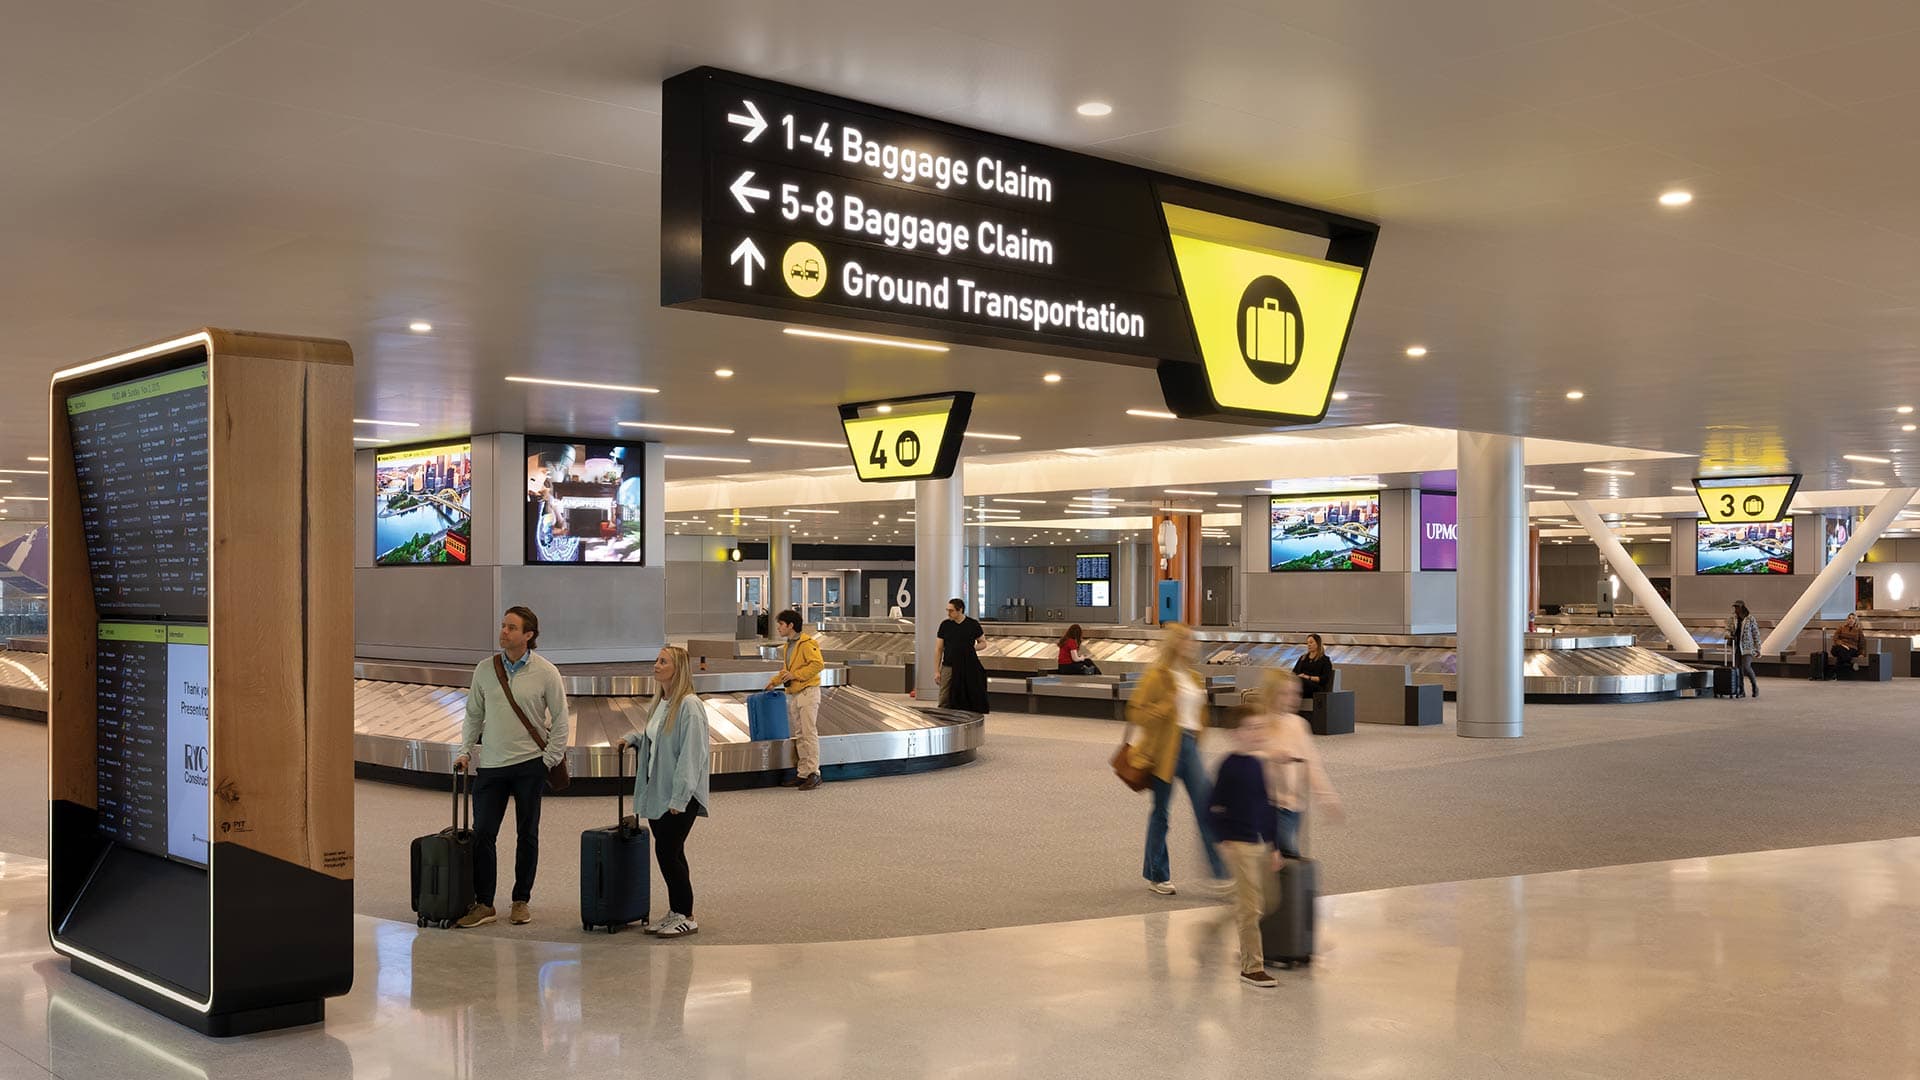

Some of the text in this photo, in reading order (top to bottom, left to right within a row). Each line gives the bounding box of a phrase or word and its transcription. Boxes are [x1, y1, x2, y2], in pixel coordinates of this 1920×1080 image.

[782, 114, 1052, 203] 1-4 Baggage Claim
[781, 183, 1053, 265] 5-8 Baggage Claim
[842, 261, 1146, 338] Ground Transportation
[869, 429, 887, 470] 4
[1719, 494, 1736, 518] 3
[896, 577, 911, 608] 6
